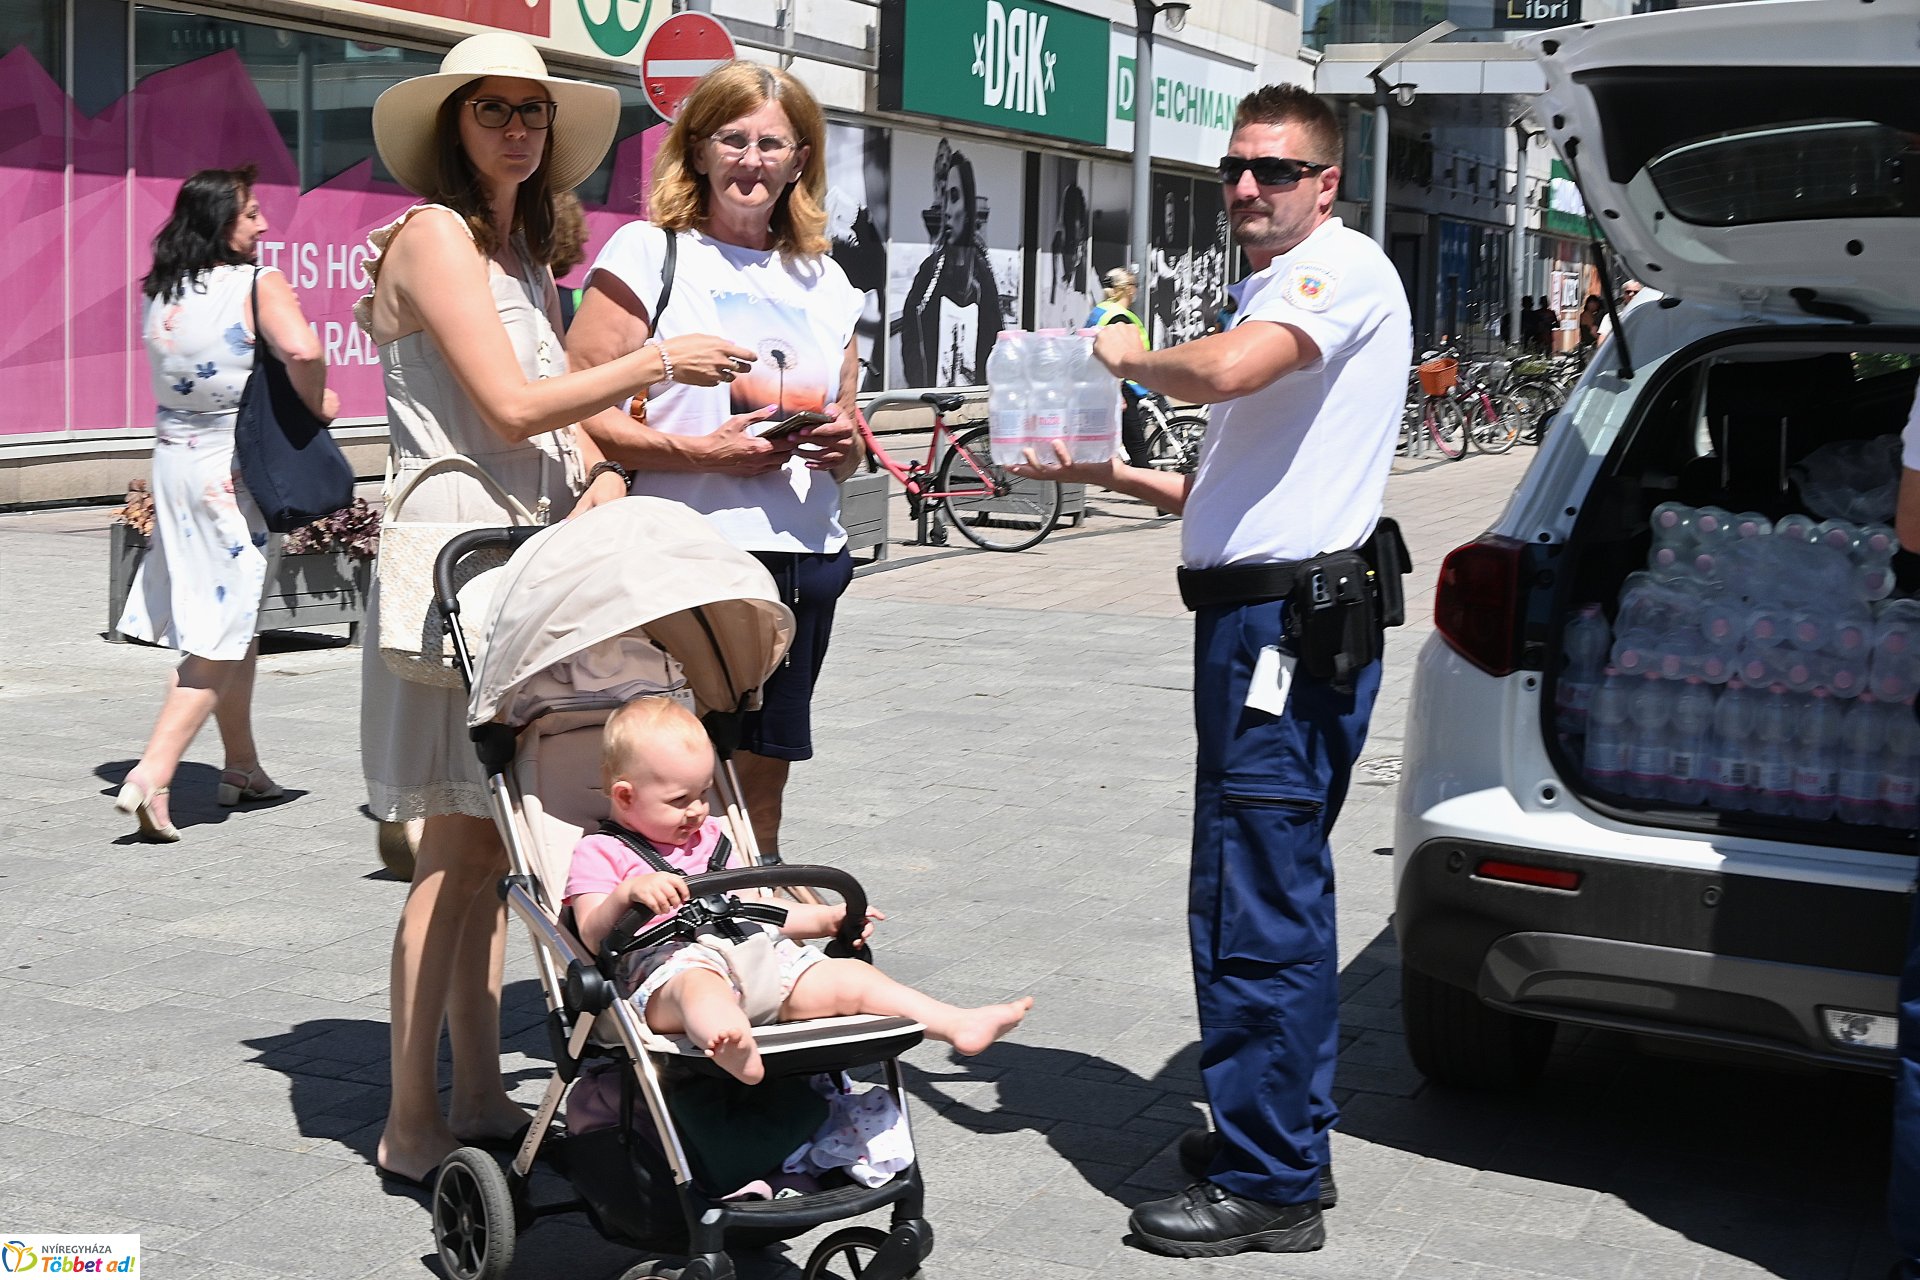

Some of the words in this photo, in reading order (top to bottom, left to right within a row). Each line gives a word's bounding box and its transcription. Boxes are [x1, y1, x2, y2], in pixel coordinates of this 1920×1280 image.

[1506, 0, 1569, 19] Libri
[1151, 77, 1237, 131] EICHMAN
[291, 242, 319, 289] IS
